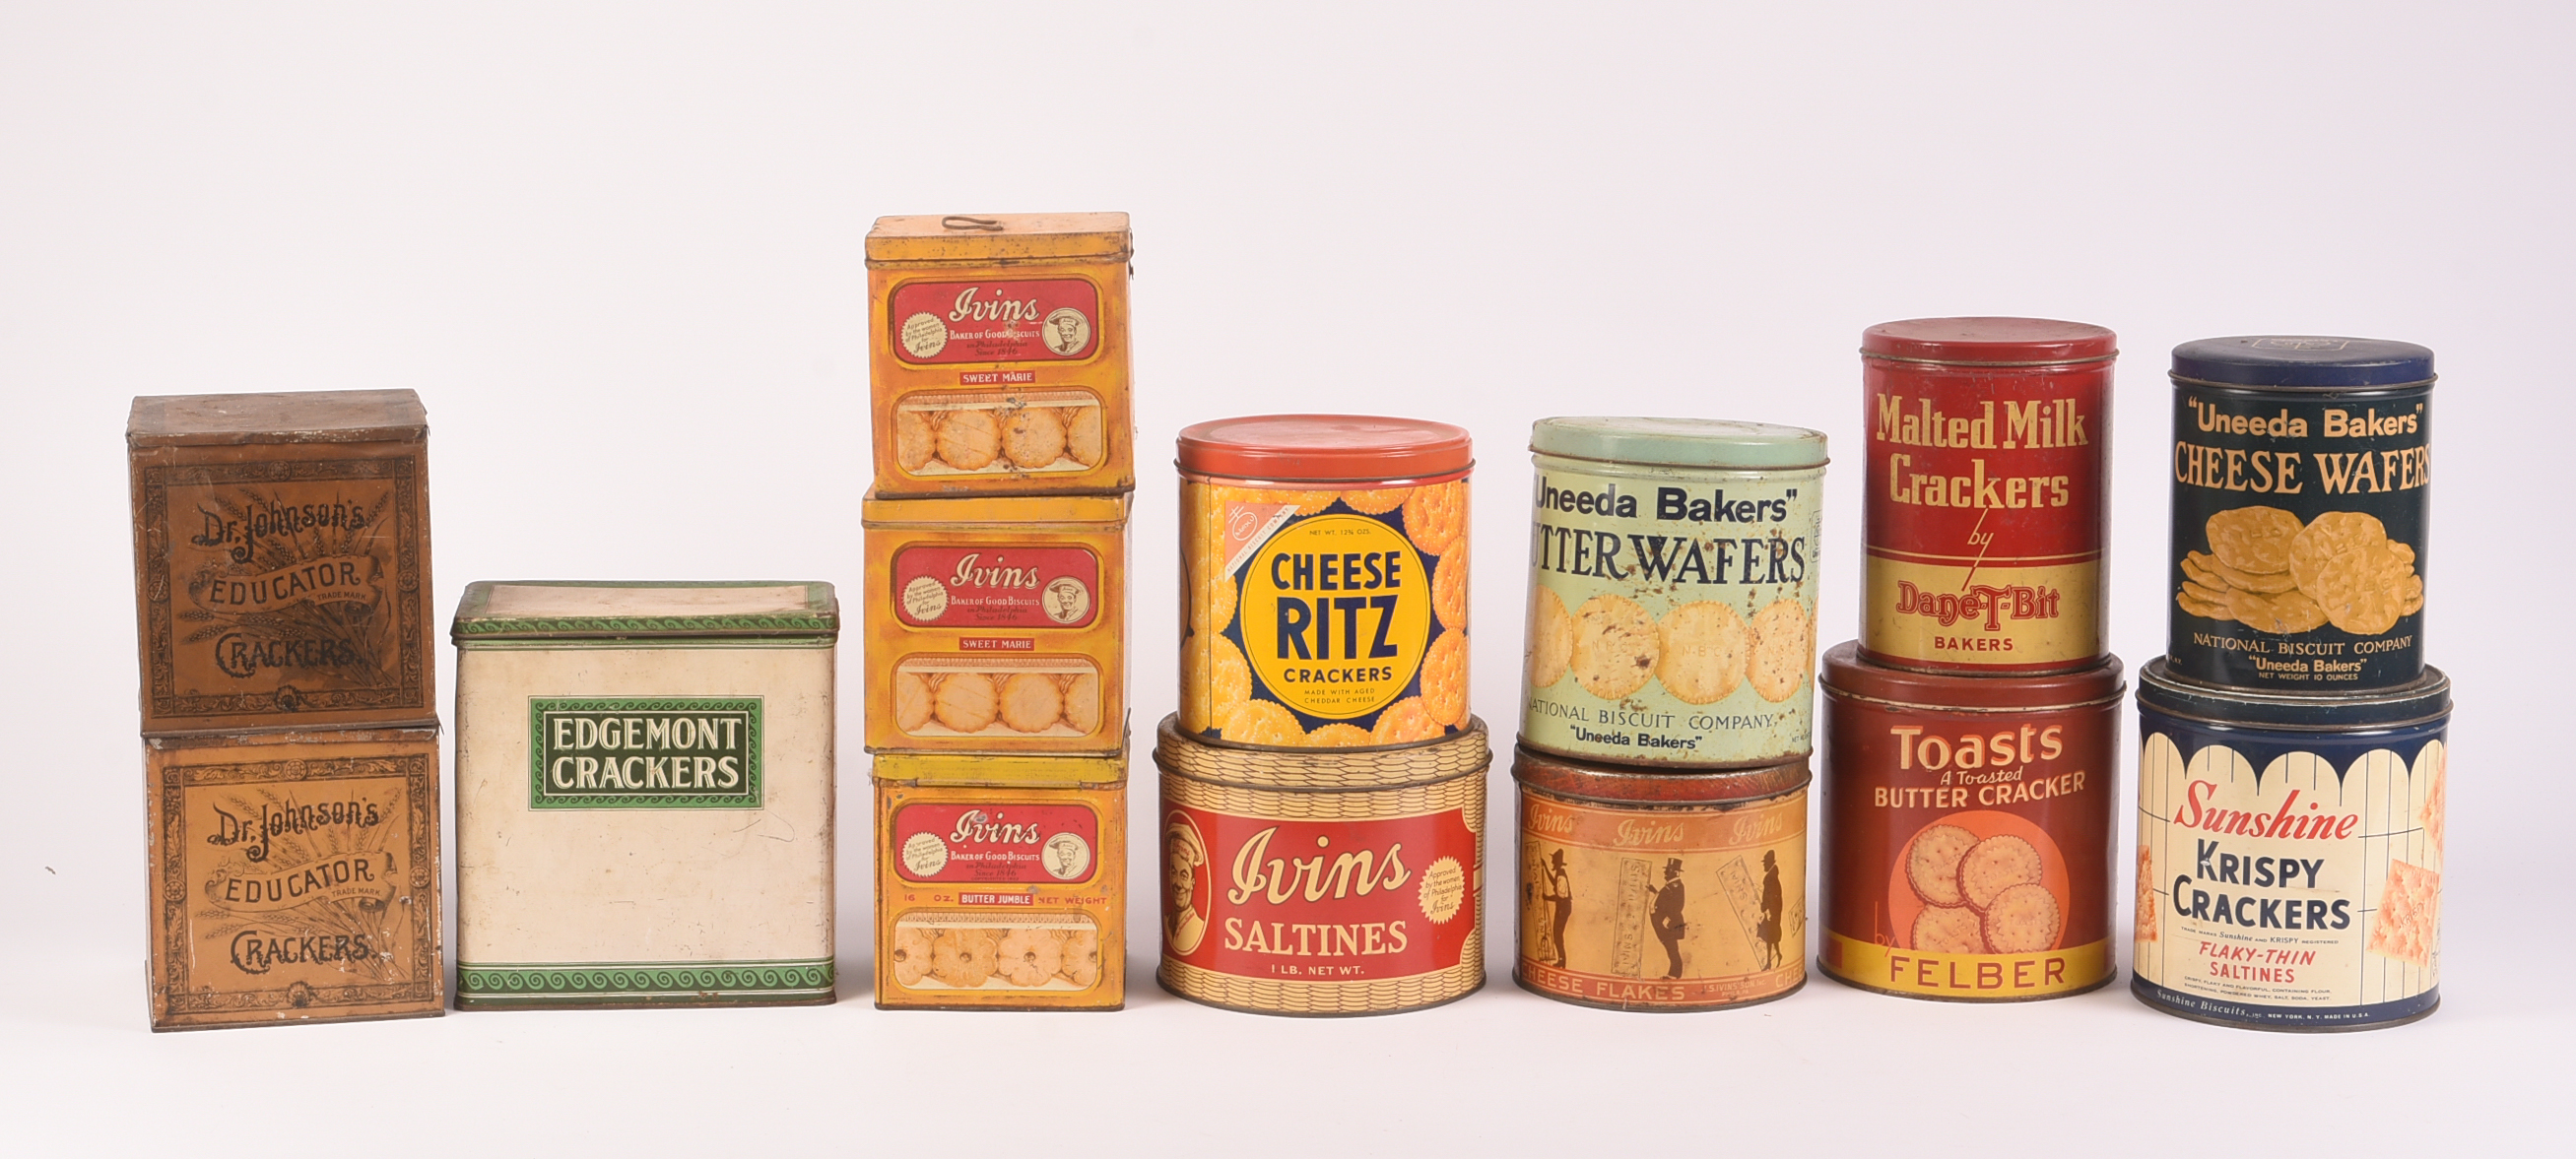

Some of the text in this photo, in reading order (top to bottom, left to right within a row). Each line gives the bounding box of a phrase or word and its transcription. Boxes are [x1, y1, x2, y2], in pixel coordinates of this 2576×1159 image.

[948, 287, 1040, 323] Ivins
[950, 329, 973, 340] BAKER
[1008, 329, 1040, 338] SCUITS
[962, 372, 1032, 383] SWEET MARIE
[1876, 393, 2088, 449] Malted Milk
[2188, 396, 2423, 438] "Uneeda Bakers"
[1889, 453, 2069, 509] Crackers
[2174, 440, 2431, 495] CHEESE WAFERS
[1656, 485, 1798, 523] Bakers"
[191, 498, 365, 564] Dr. Johnson's
[950, 552, 1040, 589] Ivins
[1271, 550, 1401, 591] CHEESE
[1531, 521, 1629, 581] UTTER
[1628, 533, 1806, 585] WAFERS
[209, 561, 362, 607] EDUCATOR
[316, 591, 341, 601] TRADE
[951, 595, 974, 606] BAKER
[985, 595, 1008, 606] GOOD
[1008, 595, 1040, 606] BISCUITS
[962, 639, 1031, 649] SWEET MARIE
[1277, 594, 1399, 661] RITZ
[1934, 636, 2014, 652] BAKERS
[2193, 632, 2412, 656] NATIONAL BISCUIT COMPANY
[1283, 666, 1393, 683] CRACKERS
[2248, 655, 2368, 673] "Uneeda Bakers"
[553, 717, 743, 751] EDGEMONT
[1569, 724, 1703, 749] "Uneeda Bakers"
[1599, 709, 1676, 729] BISCUIT
[1890, 723, 2064, 771] Toasts
[552, 755, 740, 790] CRACKERS
[1875, 770, 2086, 809] BUTTER CRACKER
[1941, 766, 2024, 786] A Toasted
[950, 808, 1040, 845] Ivins
[1528, 803, 1783, 847] Ivins Ivins Ivins
[2173, 779, 2359, 840] Sunshine
[206, 797, 379, 863] Dr. Johnson's
[951, 851, 974, 862] BAKER
[985, 851, 1007, 862] GOOD
[1008, 851, 1040, 862] BISCUITS
[1227, 825, 1413, 906] Ivins
[1428, 866, 1457, 879] Approved
[2197, 838, 2325, 889] KRISPY
[225, 858, 375, 903] EDUCATOR
[331, 887, 356, 897] TRADE
[1442, 875, 1460, 884] women
[961, 894, 995, 903] BUTTER
[997, 895, 1031, 904] JUMBLE
[1064, 896, 1107, 905] WEIGHT
[2173, 873, 2351, 931] CRACKERS
[1224, 917, 1408, 957] SALTINES
[1874, 901, 1897, 957] by
[2218, 931, 2253, 941] Sunshine
[1271, 964, 1364, 976] 1 LB. NET WT.
[2199, 940, 2317, 966] FLAKY-THIN
[1523, 963, 1685, 1000] CHEESE FLAKES
[1889, 955, 2067, 991] FELBER
[2210, 961, 2295, 983] SALTINES
[2156, 989, 2197, 1008] Sunshine
